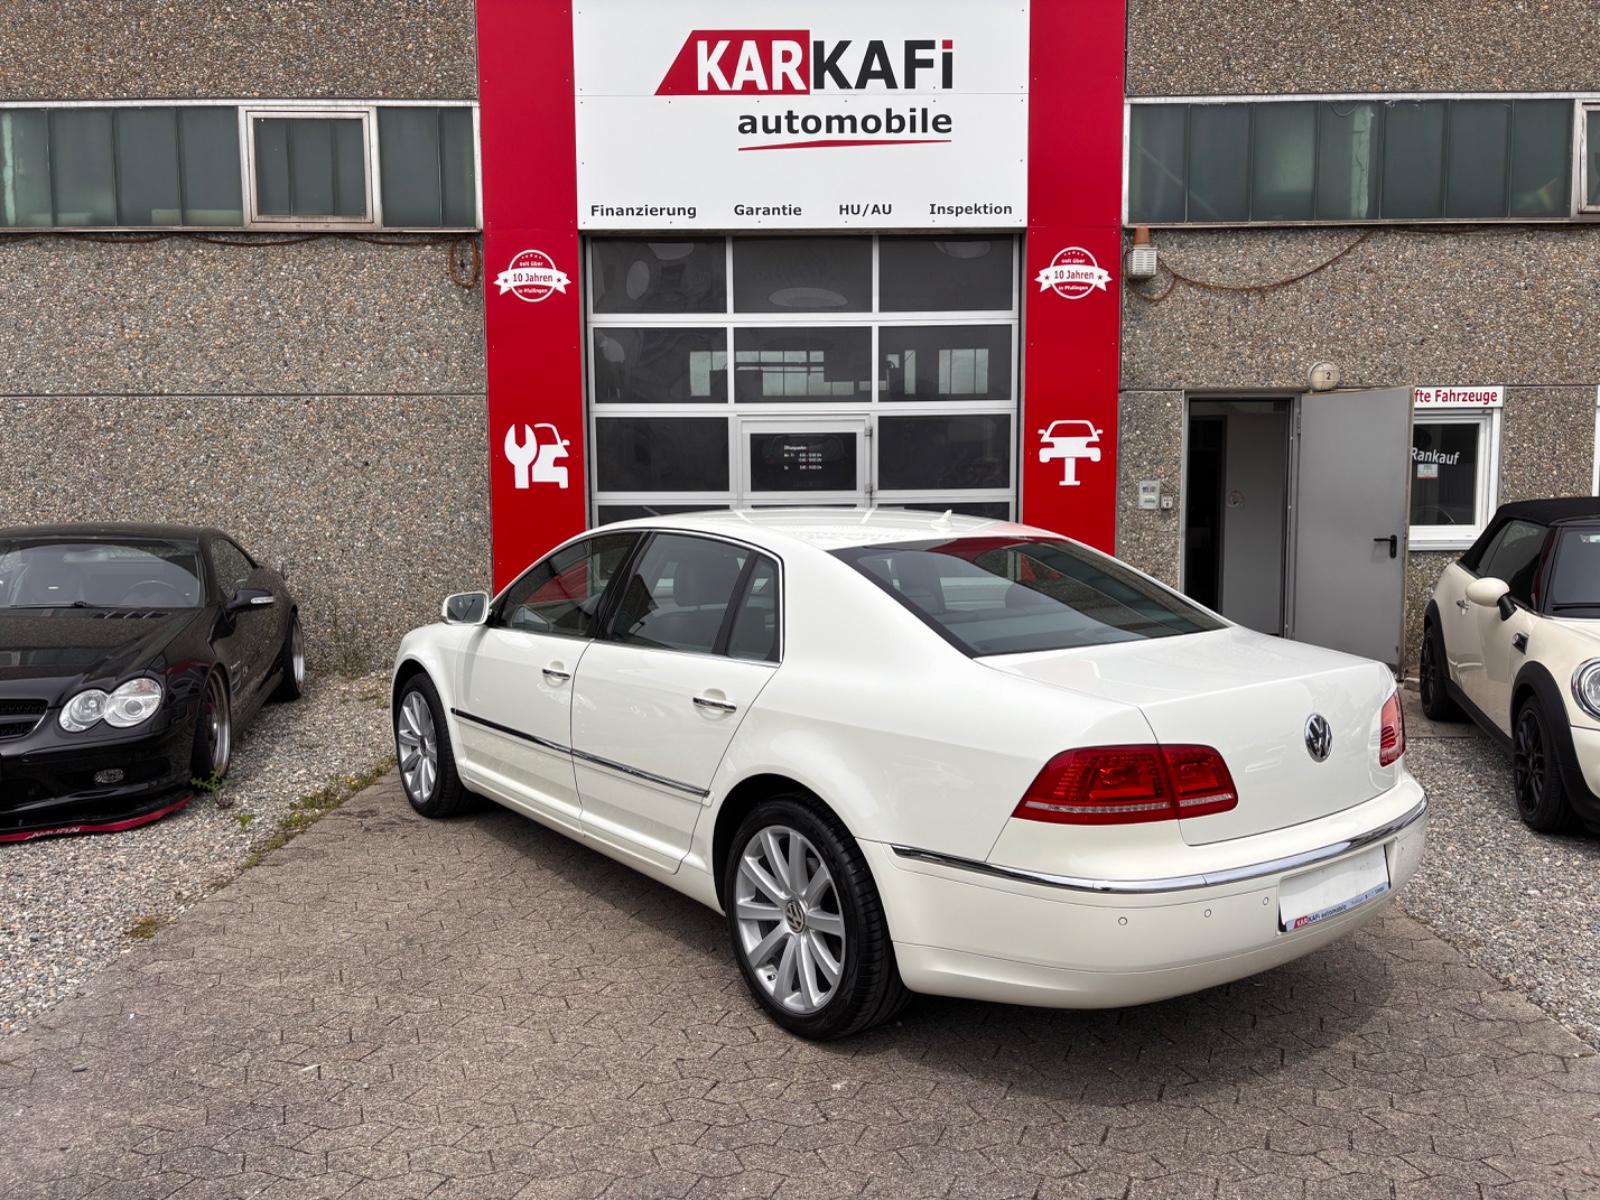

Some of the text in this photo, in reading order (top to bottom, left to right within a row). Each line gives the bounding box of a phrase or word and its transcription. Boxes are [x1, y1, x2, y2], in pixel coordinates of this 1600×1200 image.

[738, 107, 953, 134] automobile
[590, 202, 1013, 219] Finanzierung Garantie HU/AU Inspektion
[513, 273, 553, 282] 10 Jahren
[1054, 270, 1094, 279] 10 Jahren
[1435, 389, 1498, 405] Fahrzeuge
